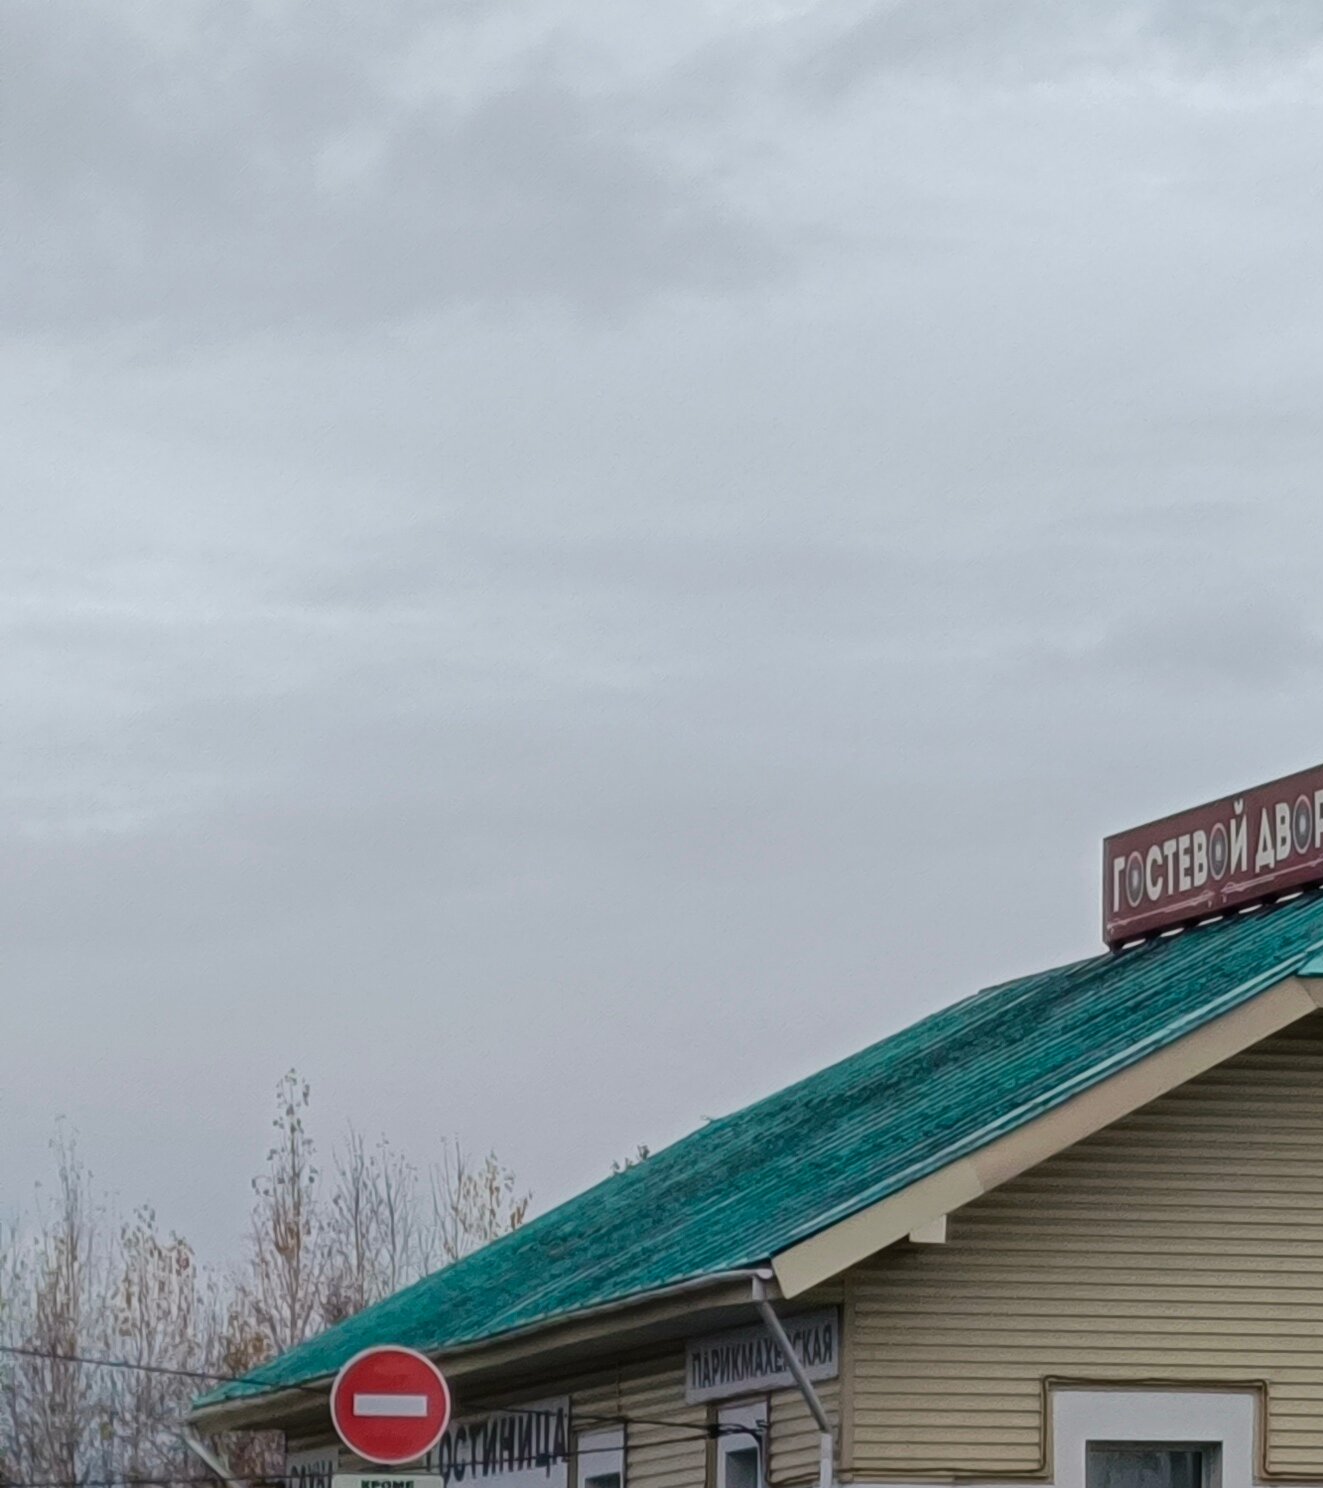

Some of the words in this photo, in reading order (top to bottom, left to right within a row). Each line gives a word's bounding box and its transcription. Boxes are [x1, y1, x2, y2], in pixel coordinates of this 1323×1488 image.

[1113, 799, 1248, 912] ГОСТЕВОЙ
[691, 1323, 833, 1388] ПАРИКМАХЕСКАЯ
[425, 1408, 567, 1486] ОСТИНИЦА
